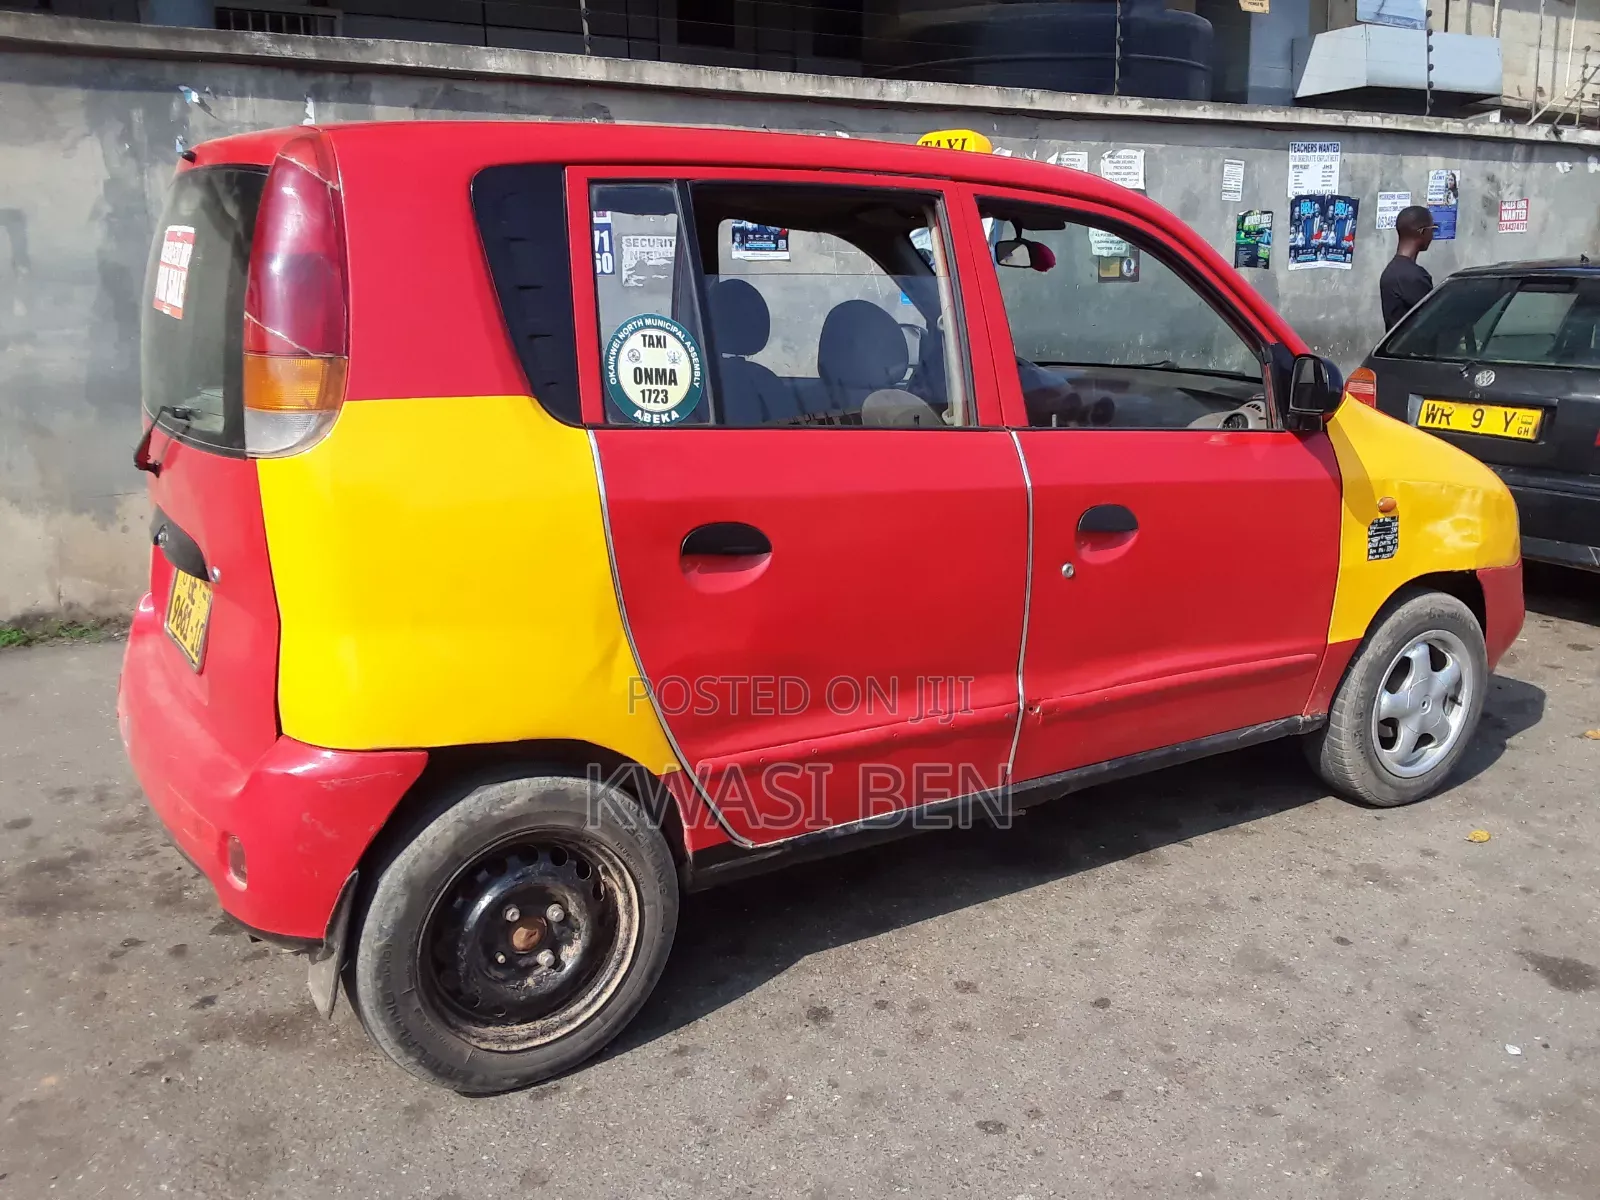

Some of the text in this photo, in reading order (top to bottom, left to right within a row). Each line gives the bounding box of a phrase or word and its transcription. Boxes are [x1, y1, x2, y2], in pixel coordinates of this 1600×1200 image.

[1290, 142, 1340, 153] TEACHERS WANTED
[1501, 209, 1527, 221] WANTED
[641, 334, 667, 349] TAXI
[608, 318, 701, 388] OKAIKWEI NORTH MUNICIPAL ASSEMBLY
[633, 366, 678, 386] ONMA
[640, 389, 669, 404] 1723
[633, 409, 680, 424] ABEKA
[1425, 403, 1517, 433] WR 9 Y
[1517, 426, 1530, 436] GH
